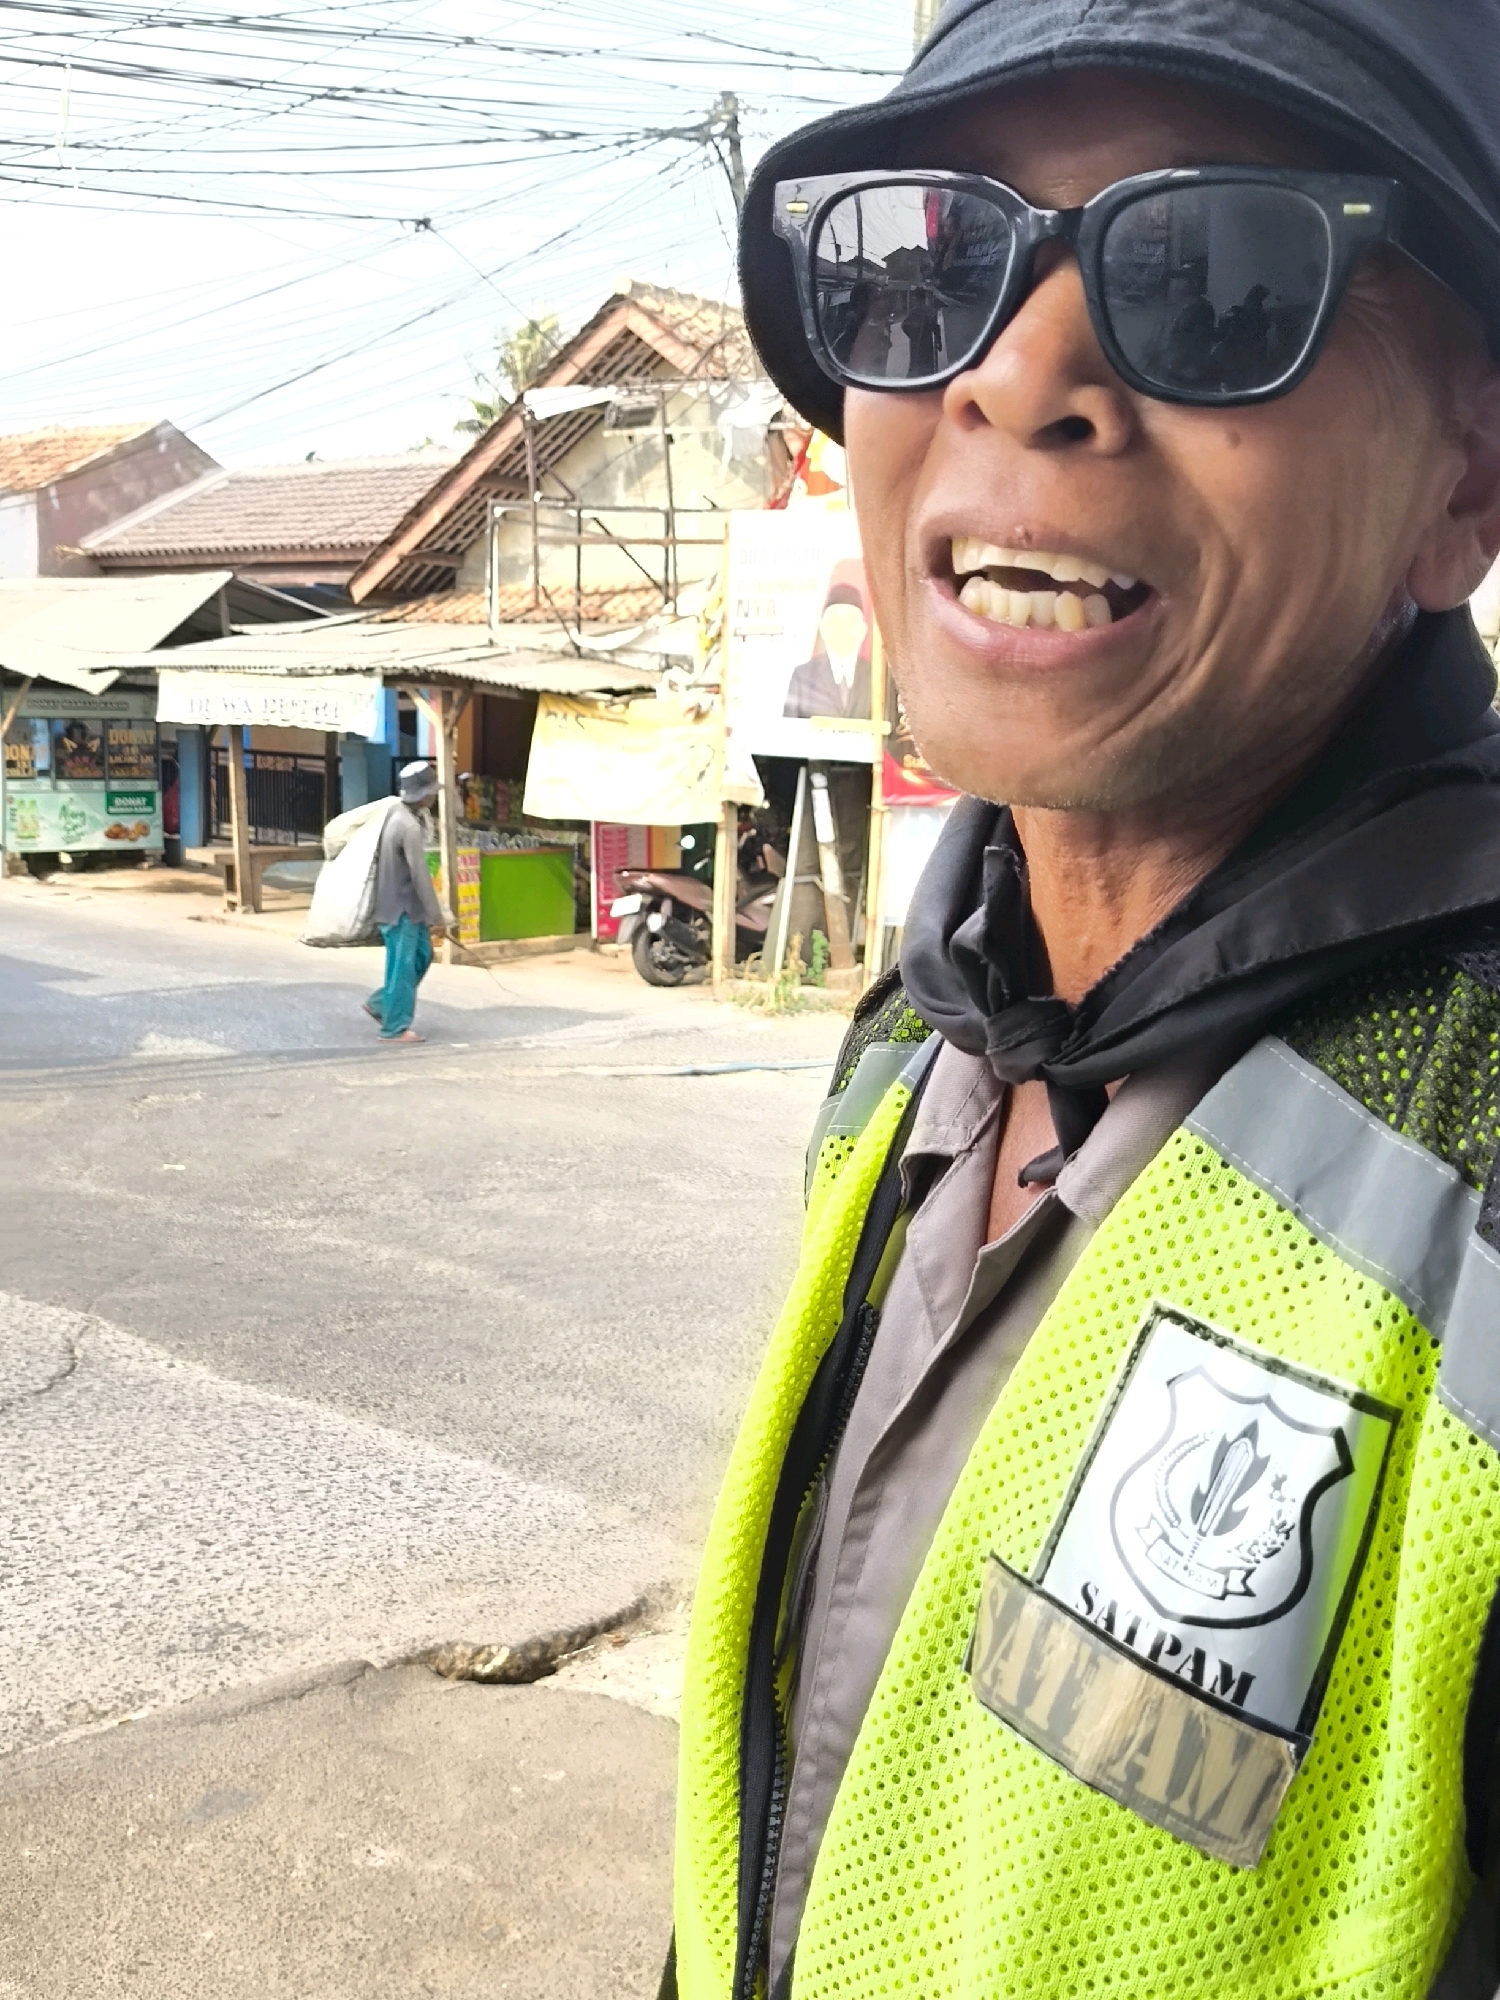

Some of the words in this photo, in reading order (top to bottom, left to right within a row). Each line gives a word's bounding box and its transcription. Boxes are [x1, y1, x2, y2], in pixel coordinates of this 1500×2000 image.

[735, 598, 777, 618] NYA
[108, 729, 155, 745] DONAT
[114, 796, 148, 806] DONAT
[1075, 1580, 1257, 1708] SATPAM
